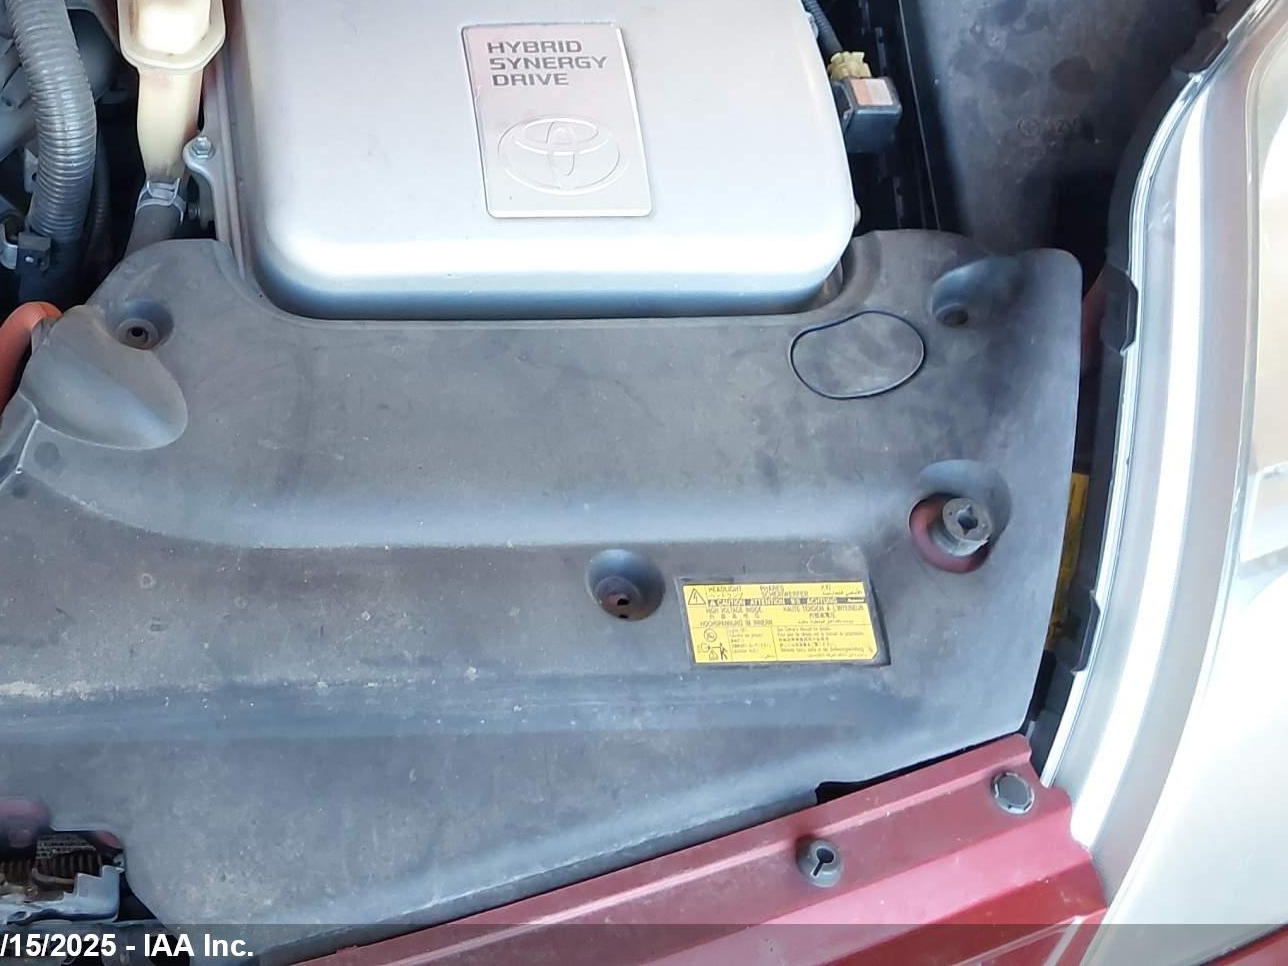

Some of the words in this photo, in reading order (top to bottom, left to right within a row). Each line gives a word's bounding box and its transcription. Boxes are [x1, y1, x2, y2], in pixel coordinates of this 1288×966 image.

[487, 40, 582, 54] HYBRID
[489, 56, 608, 70] SYNERGY
[492, 72, 570, 86] DRIVE
